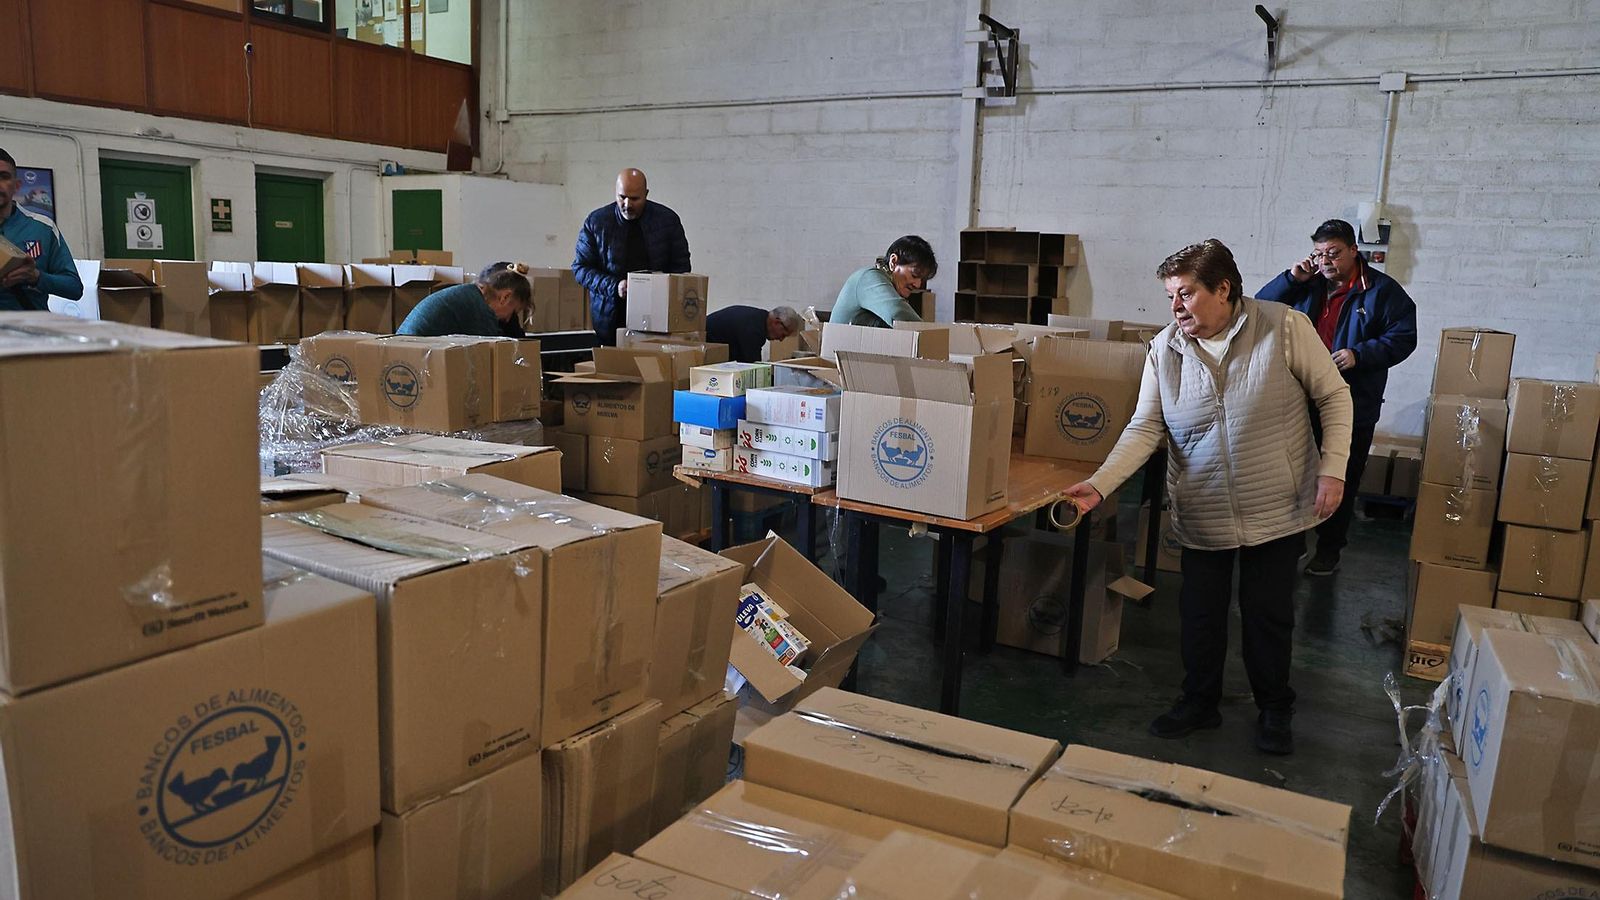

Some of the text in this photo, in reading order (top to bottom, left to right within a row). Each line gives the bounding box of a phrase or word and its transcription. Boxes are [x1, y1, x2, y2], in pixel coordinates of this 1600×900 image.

[871, 417, 935, 453] BANCOS DE ALIMENTOS
[890, 431, 916, 441] FESBAL
[871, 454, 934, 489] BANCOS DE ALIMENTOS
[735, 603, 755, 623] ULEVA
[136, 688, 306, 800] BANCOS DE ALIMENTOS
[190, 719, 260, 755] FESBAL
[140, 760, 306, 866] BANCOS DE ALIMENTOS
[1568, 886, 1585, 897] DE
